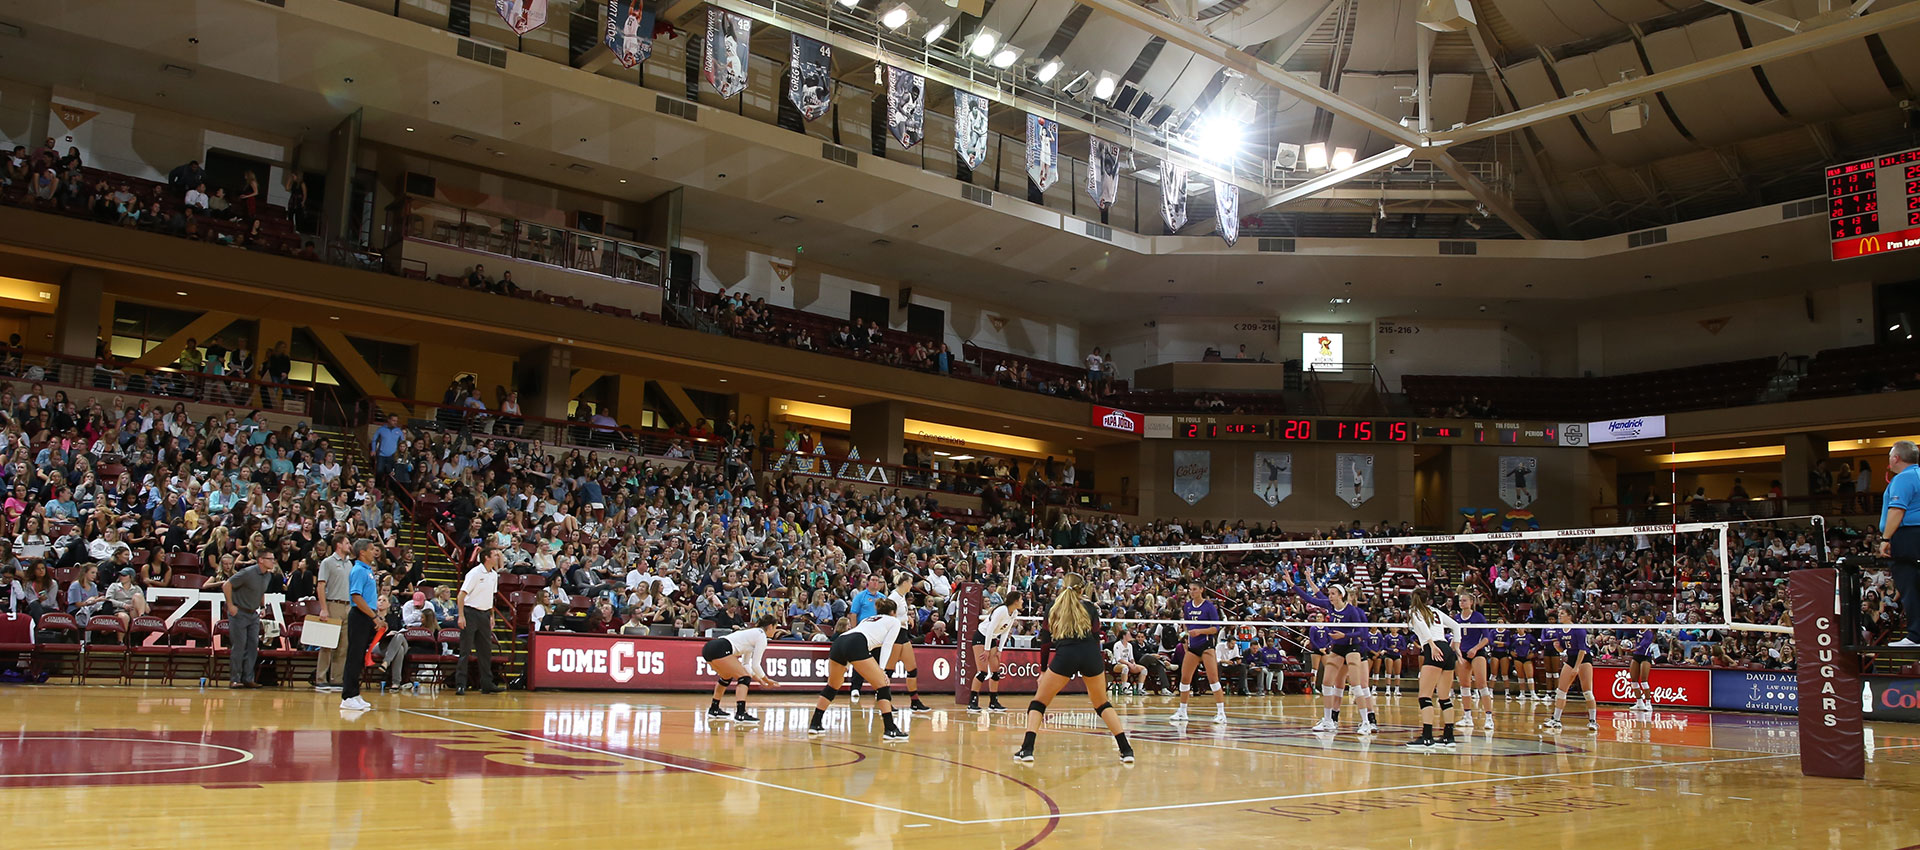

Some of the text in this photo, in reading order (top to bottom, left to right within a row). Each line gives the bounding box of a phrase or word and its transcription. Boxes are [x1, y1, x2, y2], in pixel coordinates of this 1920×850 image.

[738, 19, 750, 31] 42
[820, 46, 830, 57] 44
[791, 68, 799, 91] GREG
[1832, 208, 1843, 217] 20
[1865, 202, 1877, 211] 22
[1188, 424, 1198, 437] 2
[1212, 425, 1217, 437] 1
[1285, 420, 1310, 440] 20
[1389, 422, 1406, 441] 15
[1608, 419, 1643, 432] Hendrick
[1480, 431, 1484, 442] 1
[1512, 431, 1517, 442] 1
[1546, 428, 1554, 440] 4
[547, 641, 664, 683] COME C US
[766, 658, 788, 677] US
[791, 658, 812, 677] ON
[1816, 617, 1837, 727] COUGARS
[1431, 796, 1630, 822] COURT
